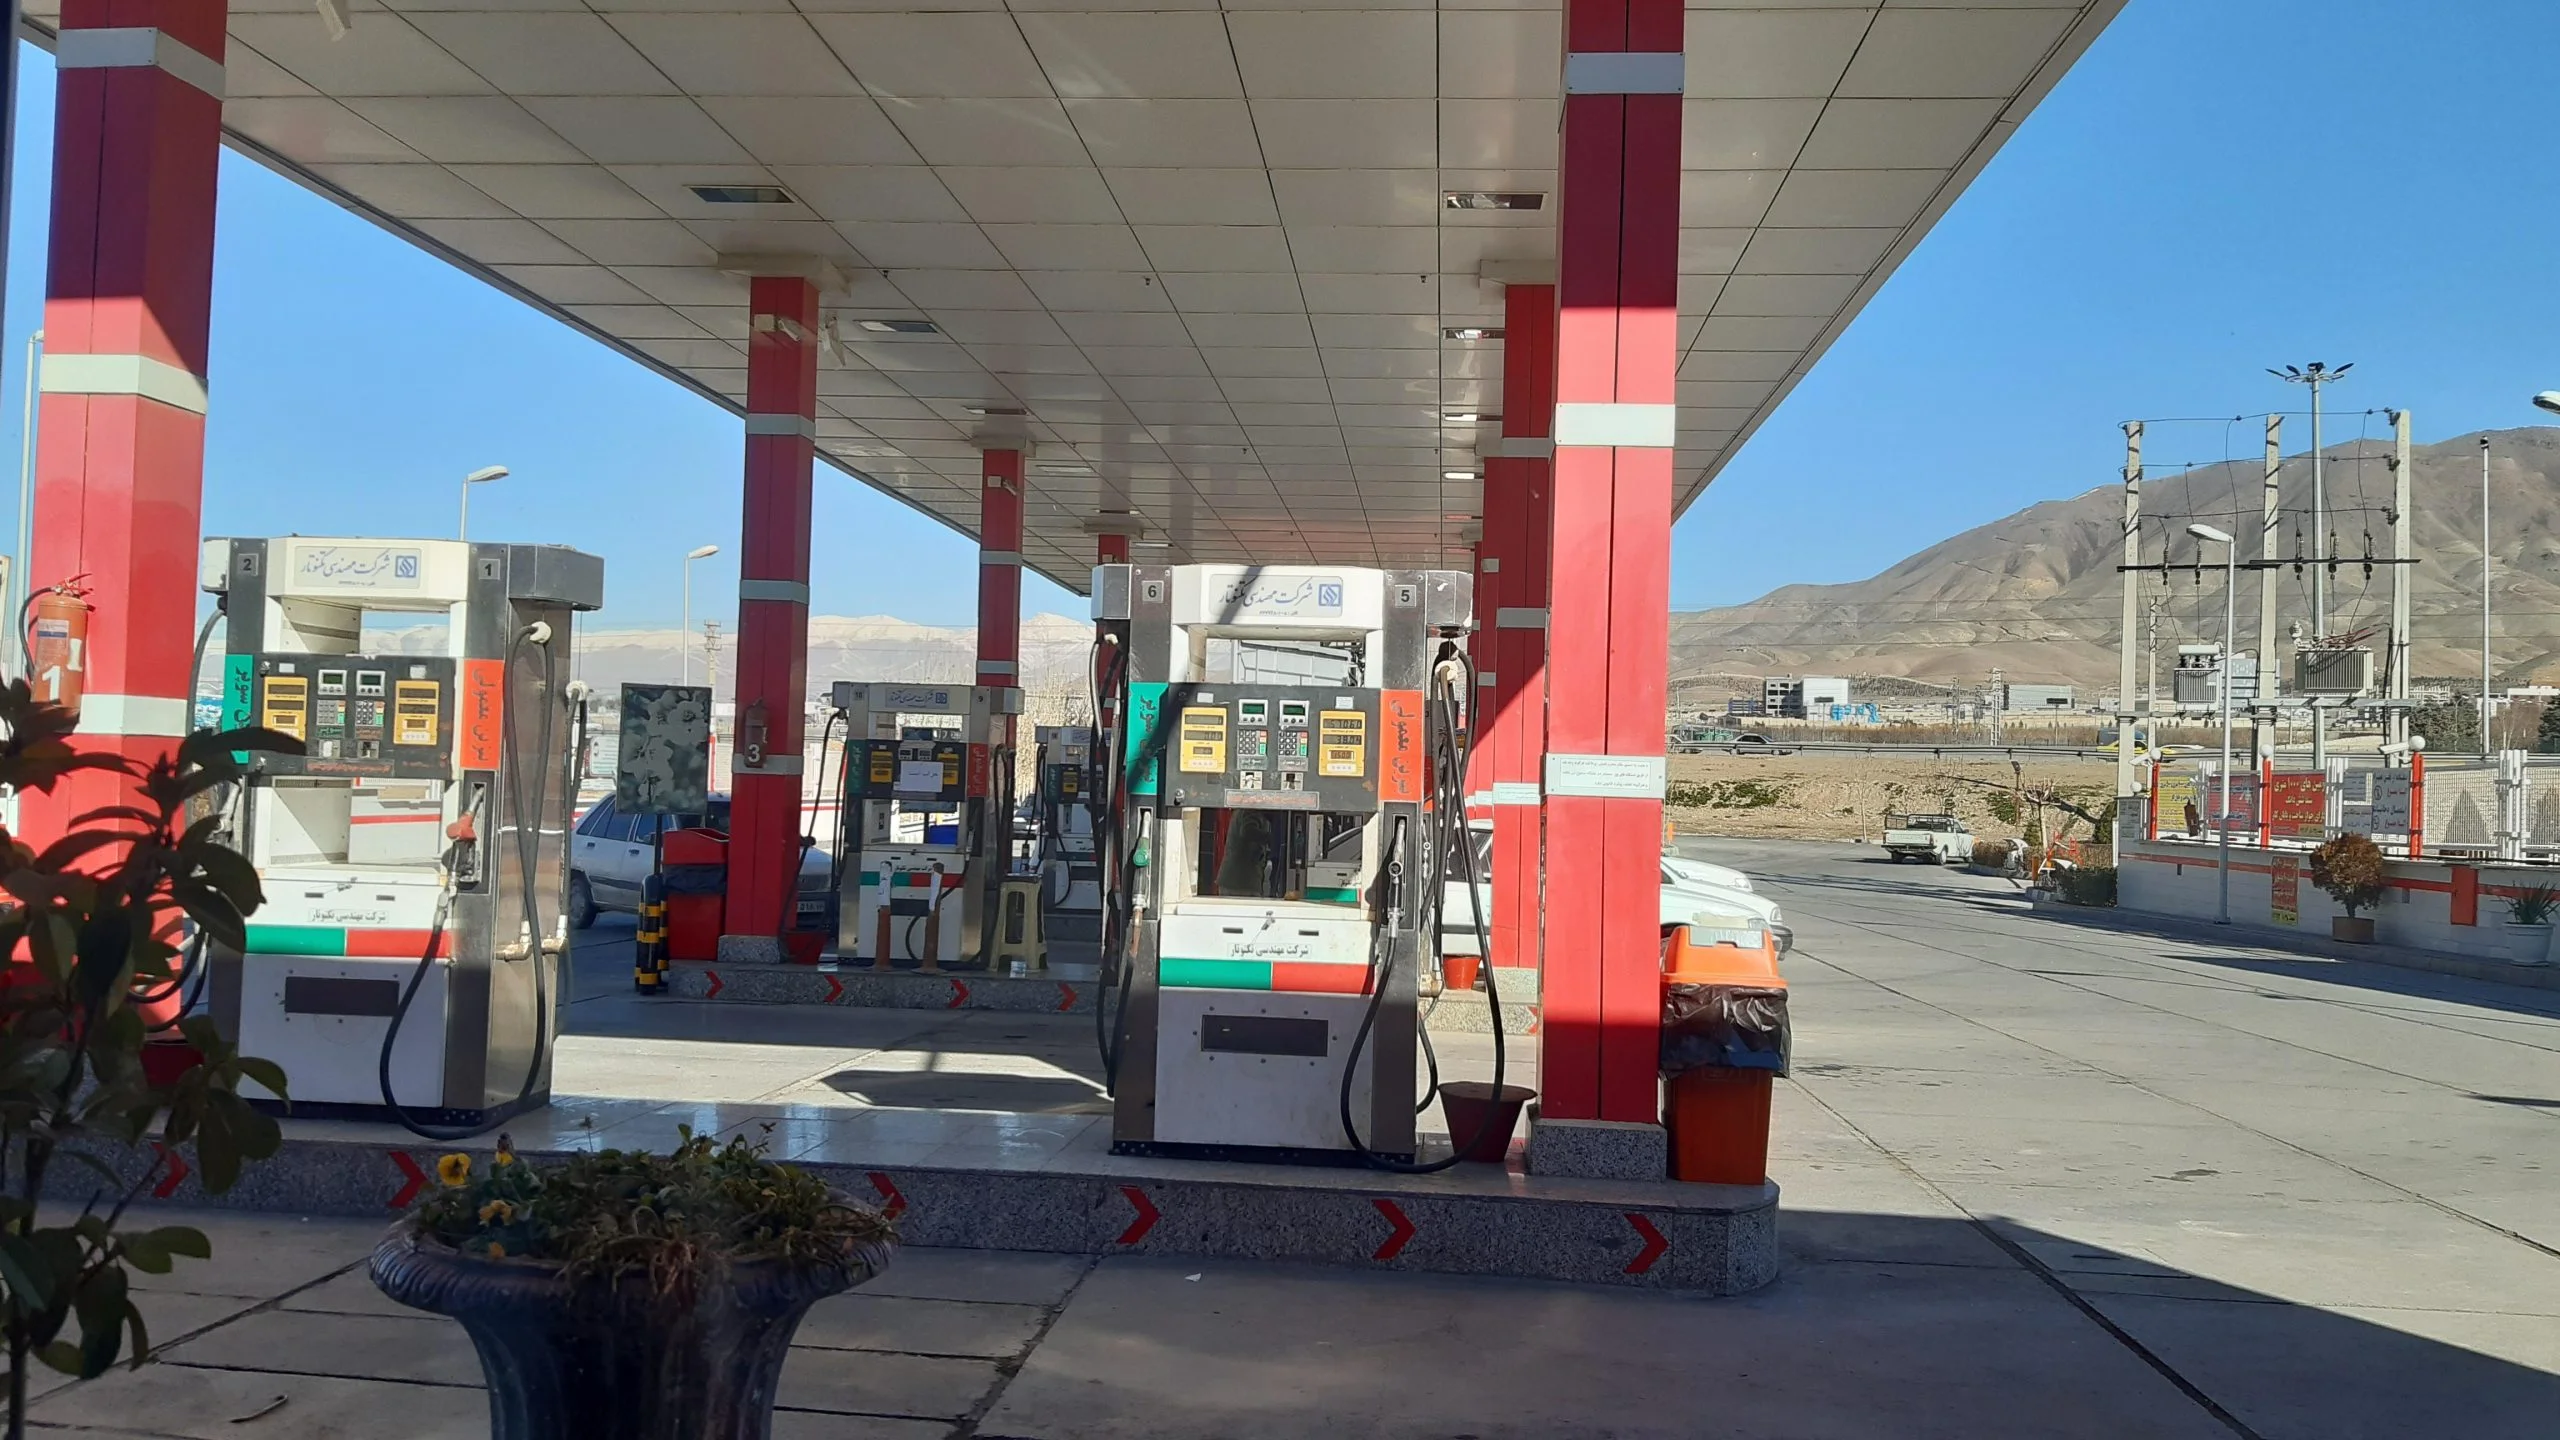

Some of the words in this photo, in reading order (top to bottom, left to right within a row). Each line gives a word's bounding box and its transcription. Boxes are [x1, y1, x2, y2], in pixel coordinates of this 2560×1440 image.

[243, 558, 252, 571] 2
[354, 547, 391, 576] شرکت
[484, 563, 492, 576] 1
[1148, 584, 1157, 598] 6
[1275, 576, 1313, 606] شرکت
[1401, 589, 1410, 602] 5
[42, 664, 61, 700] 1
[235, 666, 251, 704] سوپر
[1140, 695, 1157, 734] سوپر
[1391, 700, 1416, 751] معمولی
[748, 744, 760, 762] 3
[1286, 944, 1309, 958] شرکت
